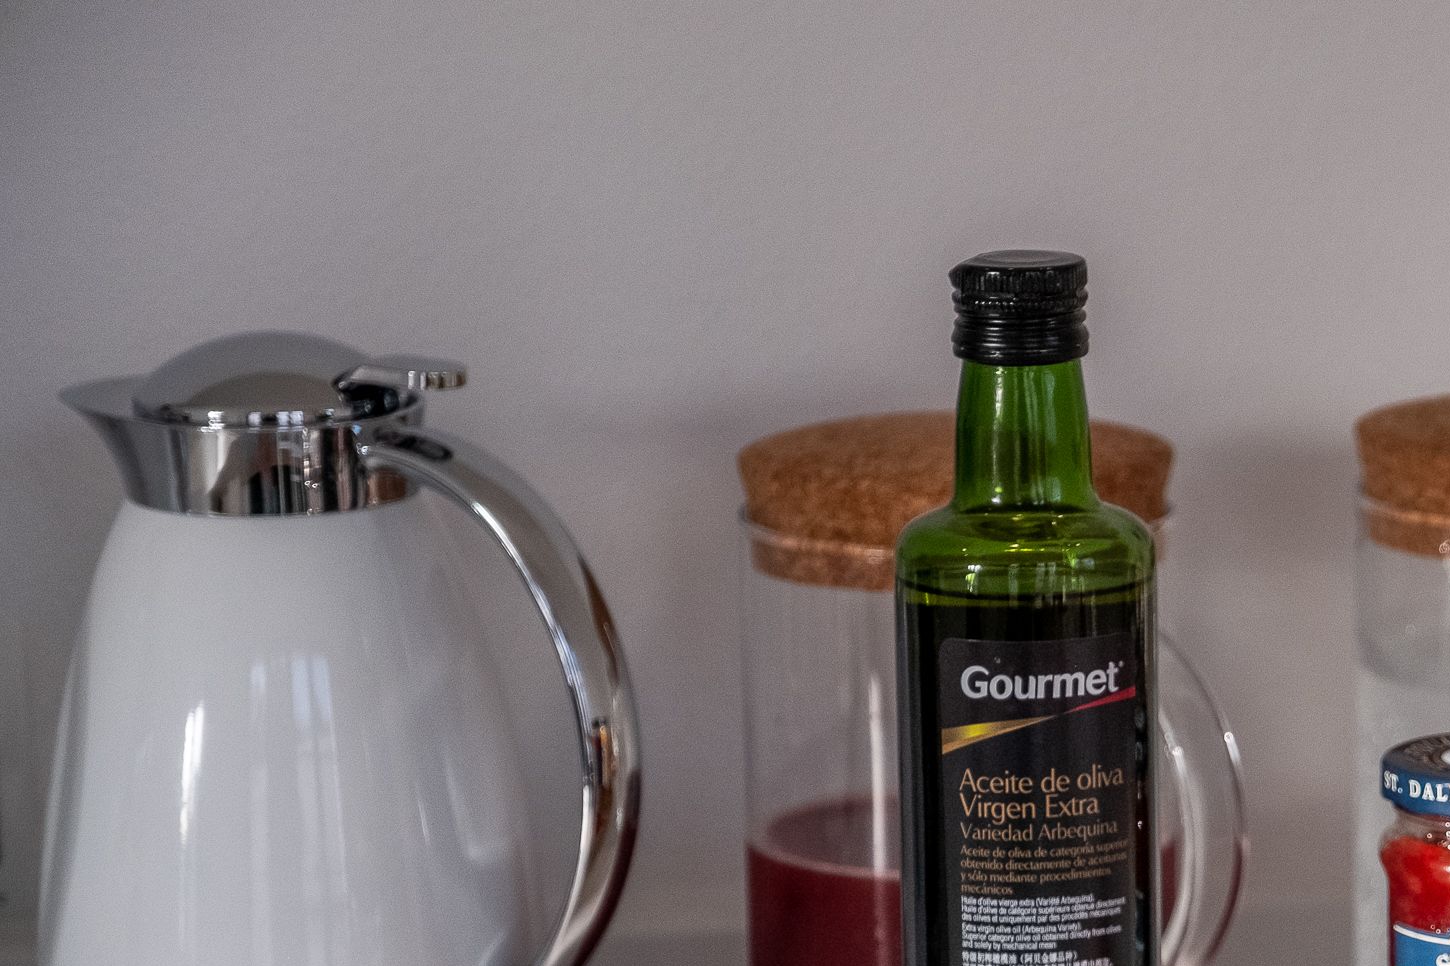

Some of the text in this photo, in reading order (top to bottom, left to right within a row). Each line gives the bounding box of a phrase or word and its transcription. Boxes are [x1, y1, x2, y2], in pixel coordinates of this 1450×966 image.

[960, 660, 1119, 700] Gourmet
[959, 763, 1124, 794] Aceite de oliva
[1383, 770, 1403, 794] ST.
[959, 793, 1100, 826] Virgen Extra
[960, 819, 1119, 842] Variedad Arbequina
[960, 844, 991, 857] Aceite
[992, 847, 1006, 858] de
[1007, 847, 1032, 858] oliva
[1033, 847, 1047, 857] de
[960, 857, 1003, 870] obtenido
[1005, 858, 1071, 871] directamente
[1073, 856, 1086, 867] de
[989, 871, 1038, 883] mediante
[1040, 867, 1112, 885] procedimientos
[961, 882, 1014, 895] mecánicos
